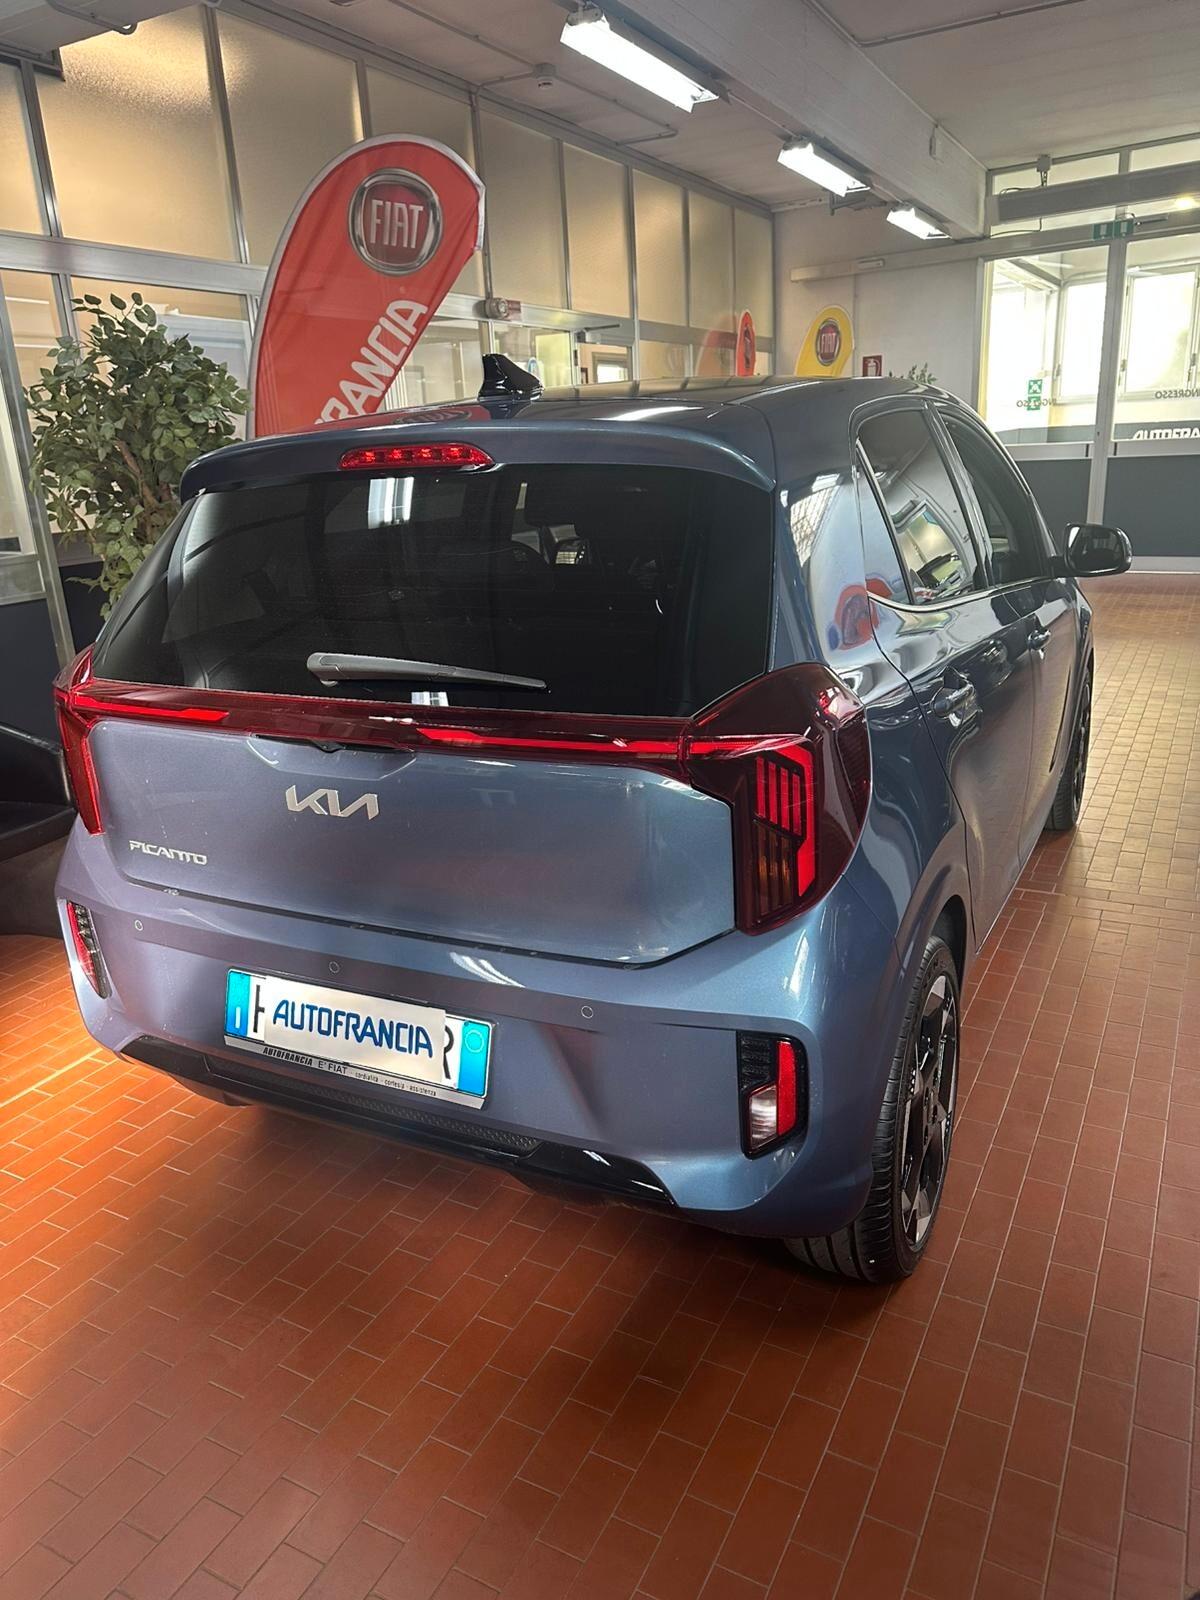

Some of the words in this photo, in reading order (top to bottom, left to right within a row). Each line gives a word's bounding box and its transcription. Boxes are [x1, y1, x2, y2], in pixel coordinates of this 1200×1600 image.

[370, 199, 424, 249] FIAT
[314, 299, 428, 425] RANCIA
[285, 785, 379, 820] KIA
[129, 840, 207, 865] PICANTO
[273, 999, 433, 1058] AUTOFRANCIA
[263, 1046, 313, 1066] AUTOFRANCIA
[328, 1062, 348, 1074] FIAT
